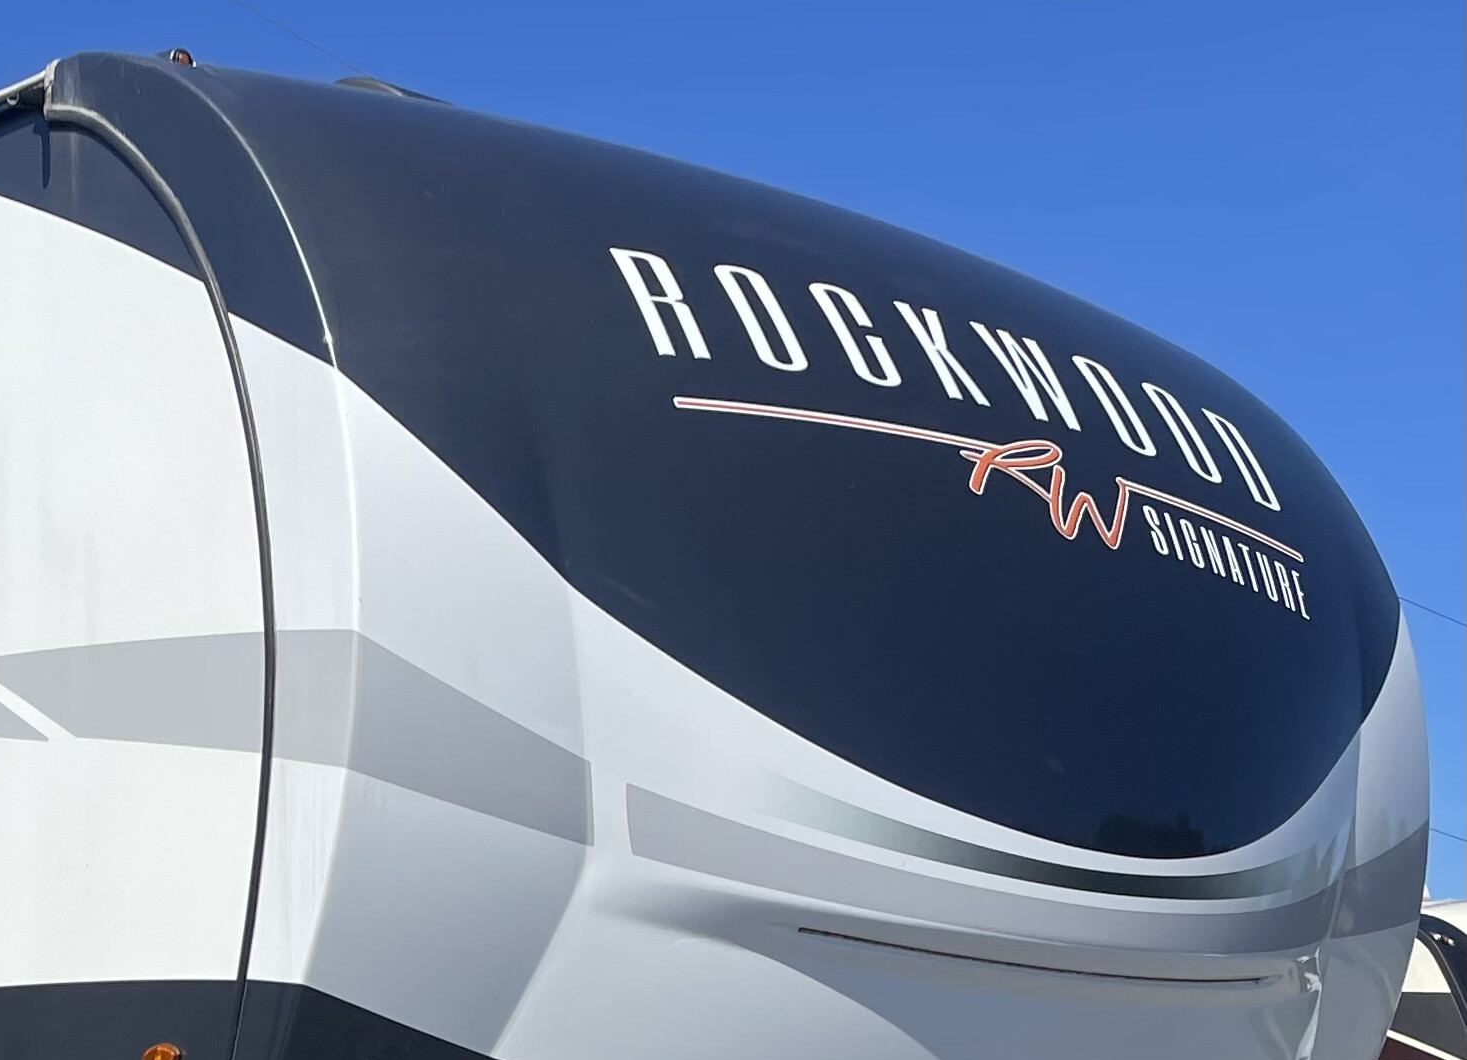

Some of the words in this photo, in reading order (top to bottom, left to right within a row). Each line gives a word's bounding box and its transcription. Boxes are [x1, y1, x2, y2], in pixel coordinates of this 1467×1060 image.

[609, 246, 1282, 512] ROCKWOOD
[960, 439, 1132, 550] RW
[1141, 504, 1311, 621] SIGNATURE
